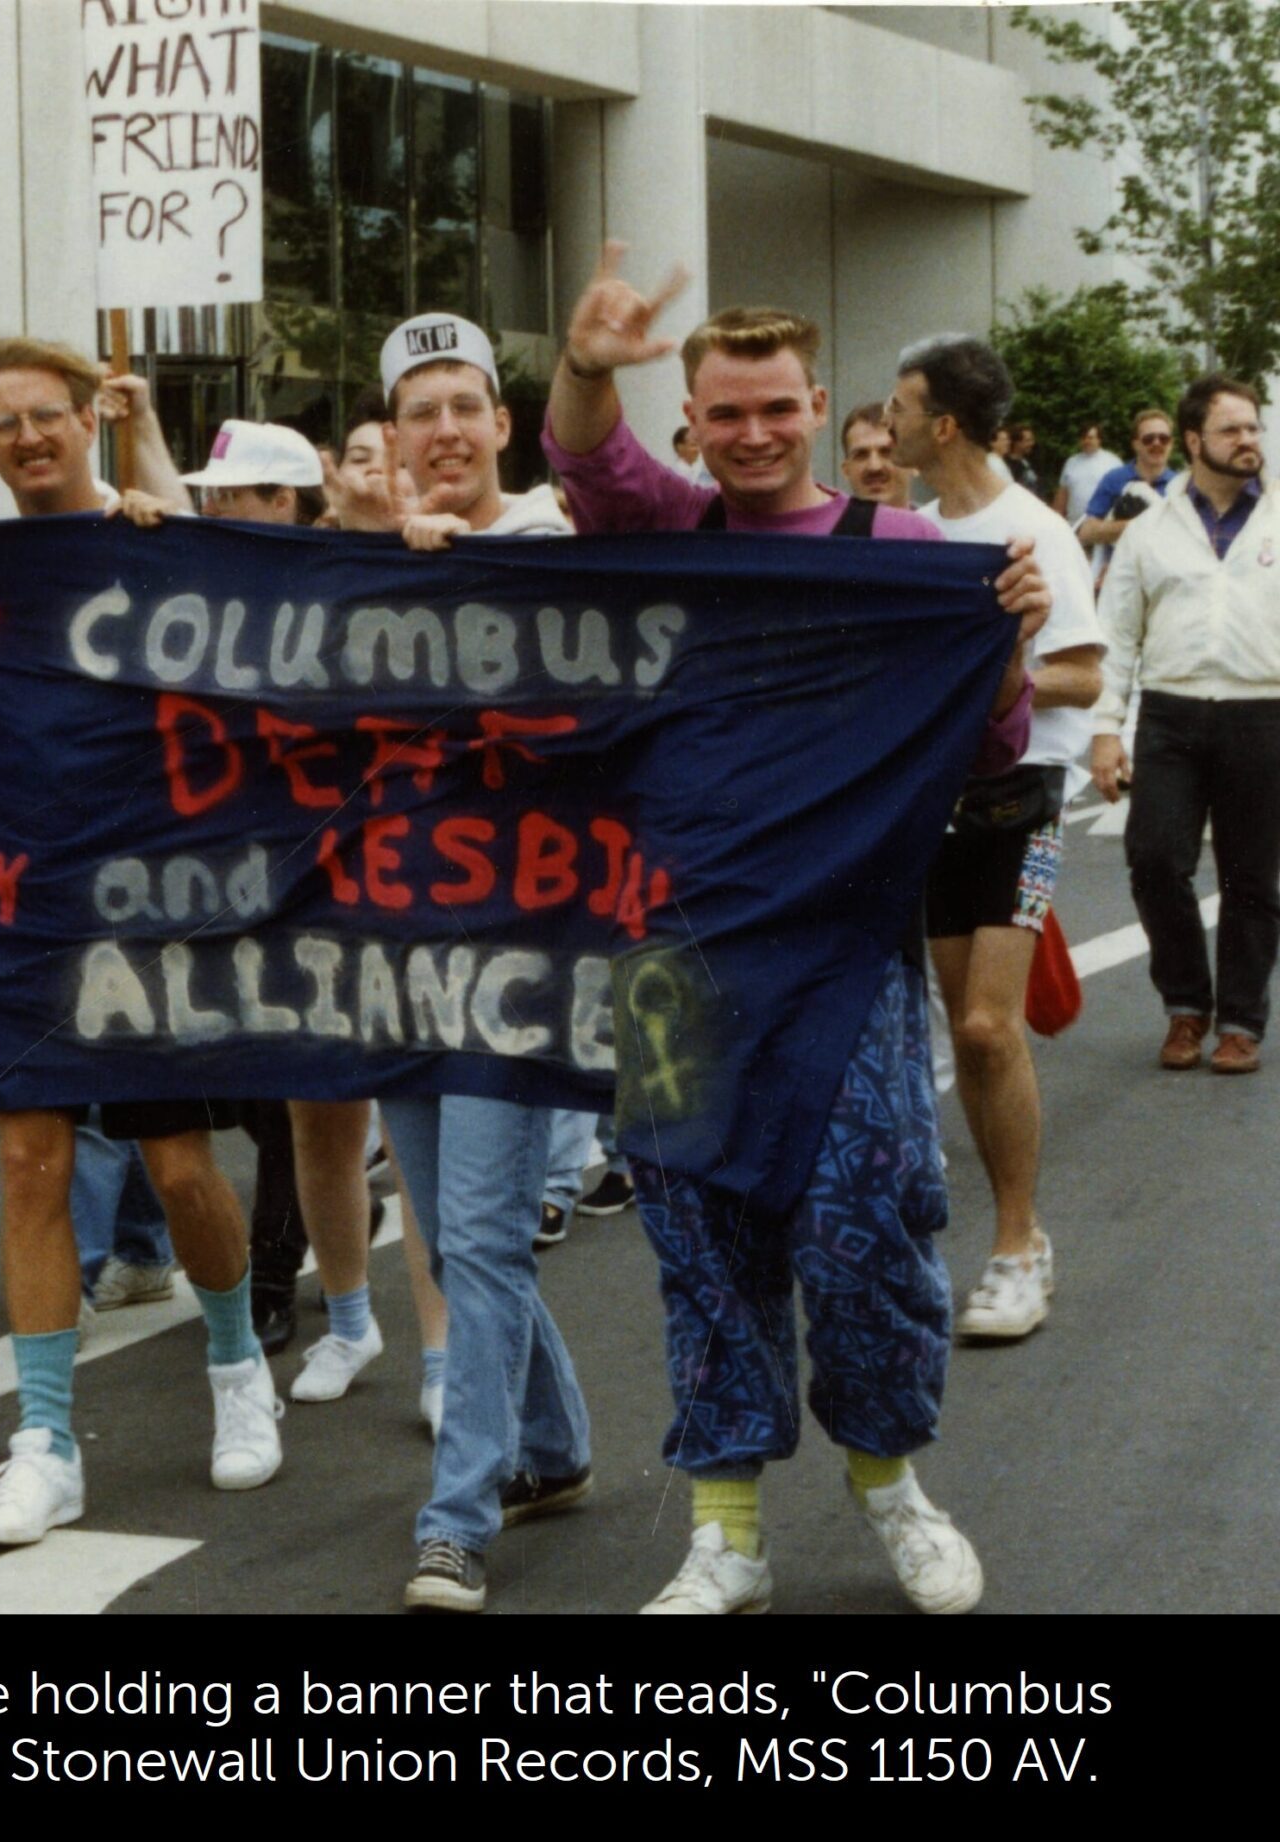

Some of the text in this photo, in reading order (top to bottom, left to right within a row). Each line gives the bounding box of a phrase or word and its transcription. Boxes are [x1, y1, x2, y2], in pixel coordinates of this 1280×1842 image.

[85, 27, 255, 99] WHAT
[99, 190, 192, 247] FOR
[409, 323, 457, 354] ACT UP
[68, 580, 687, 693] COLUMBUS
[156, 693, 577, 816] DEAF
[93, 843, 272, 922] and
[73, 934, 617, 1072] ALLIANCE
